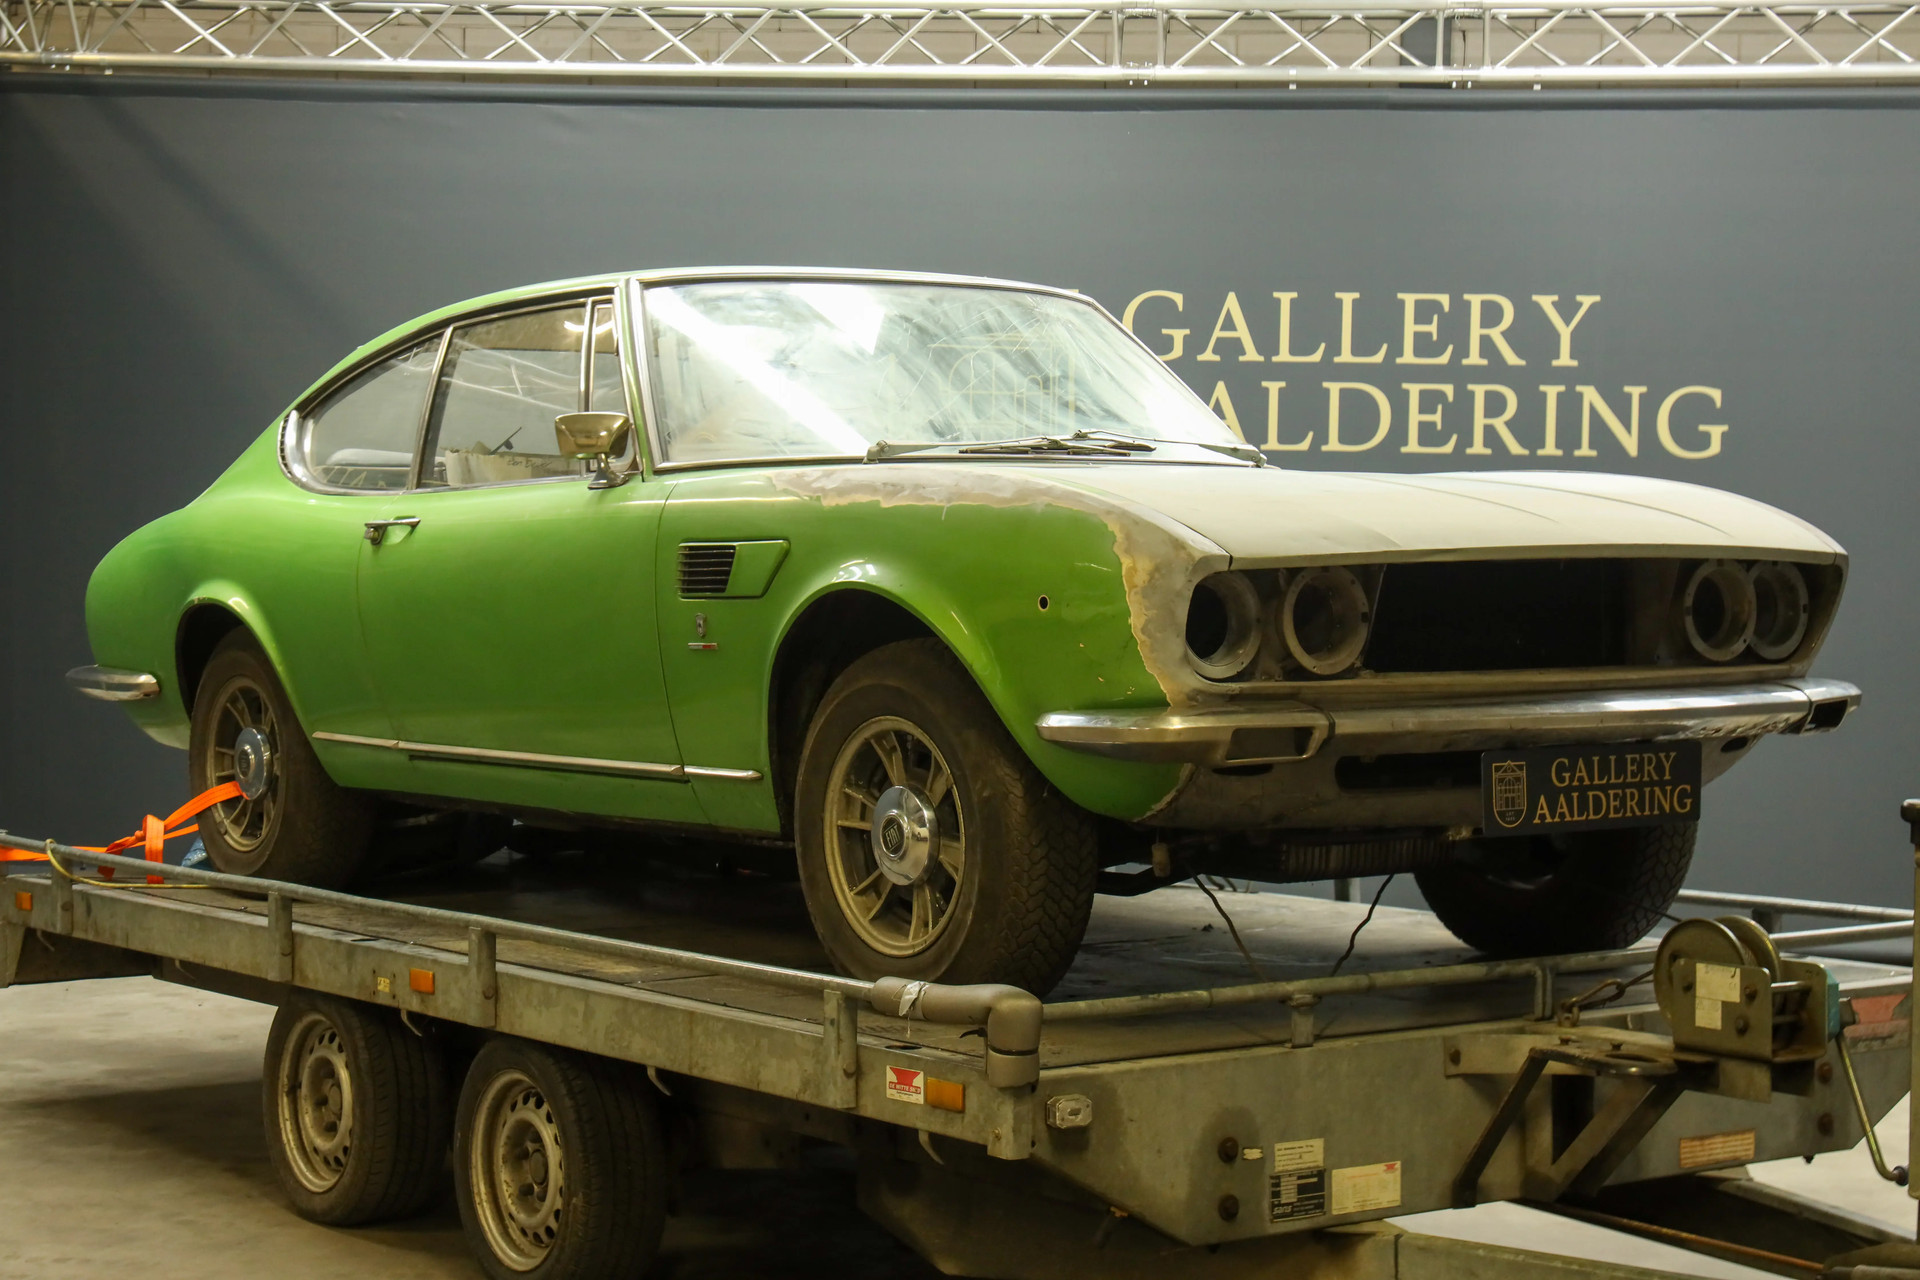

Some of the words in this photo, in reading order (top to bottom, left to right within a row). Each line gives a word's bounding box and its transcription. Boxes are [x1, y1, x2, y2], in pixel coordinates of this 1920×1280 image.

[1121, 289, 1602, 367] GALLERY
[1207, 380, 1729, 460] ALDERING
[1551, 752, 1677, 788] GALLERY
[1533, 784, 1693, 823] AALDERING
[885, 824, 900, 848] FIAT
